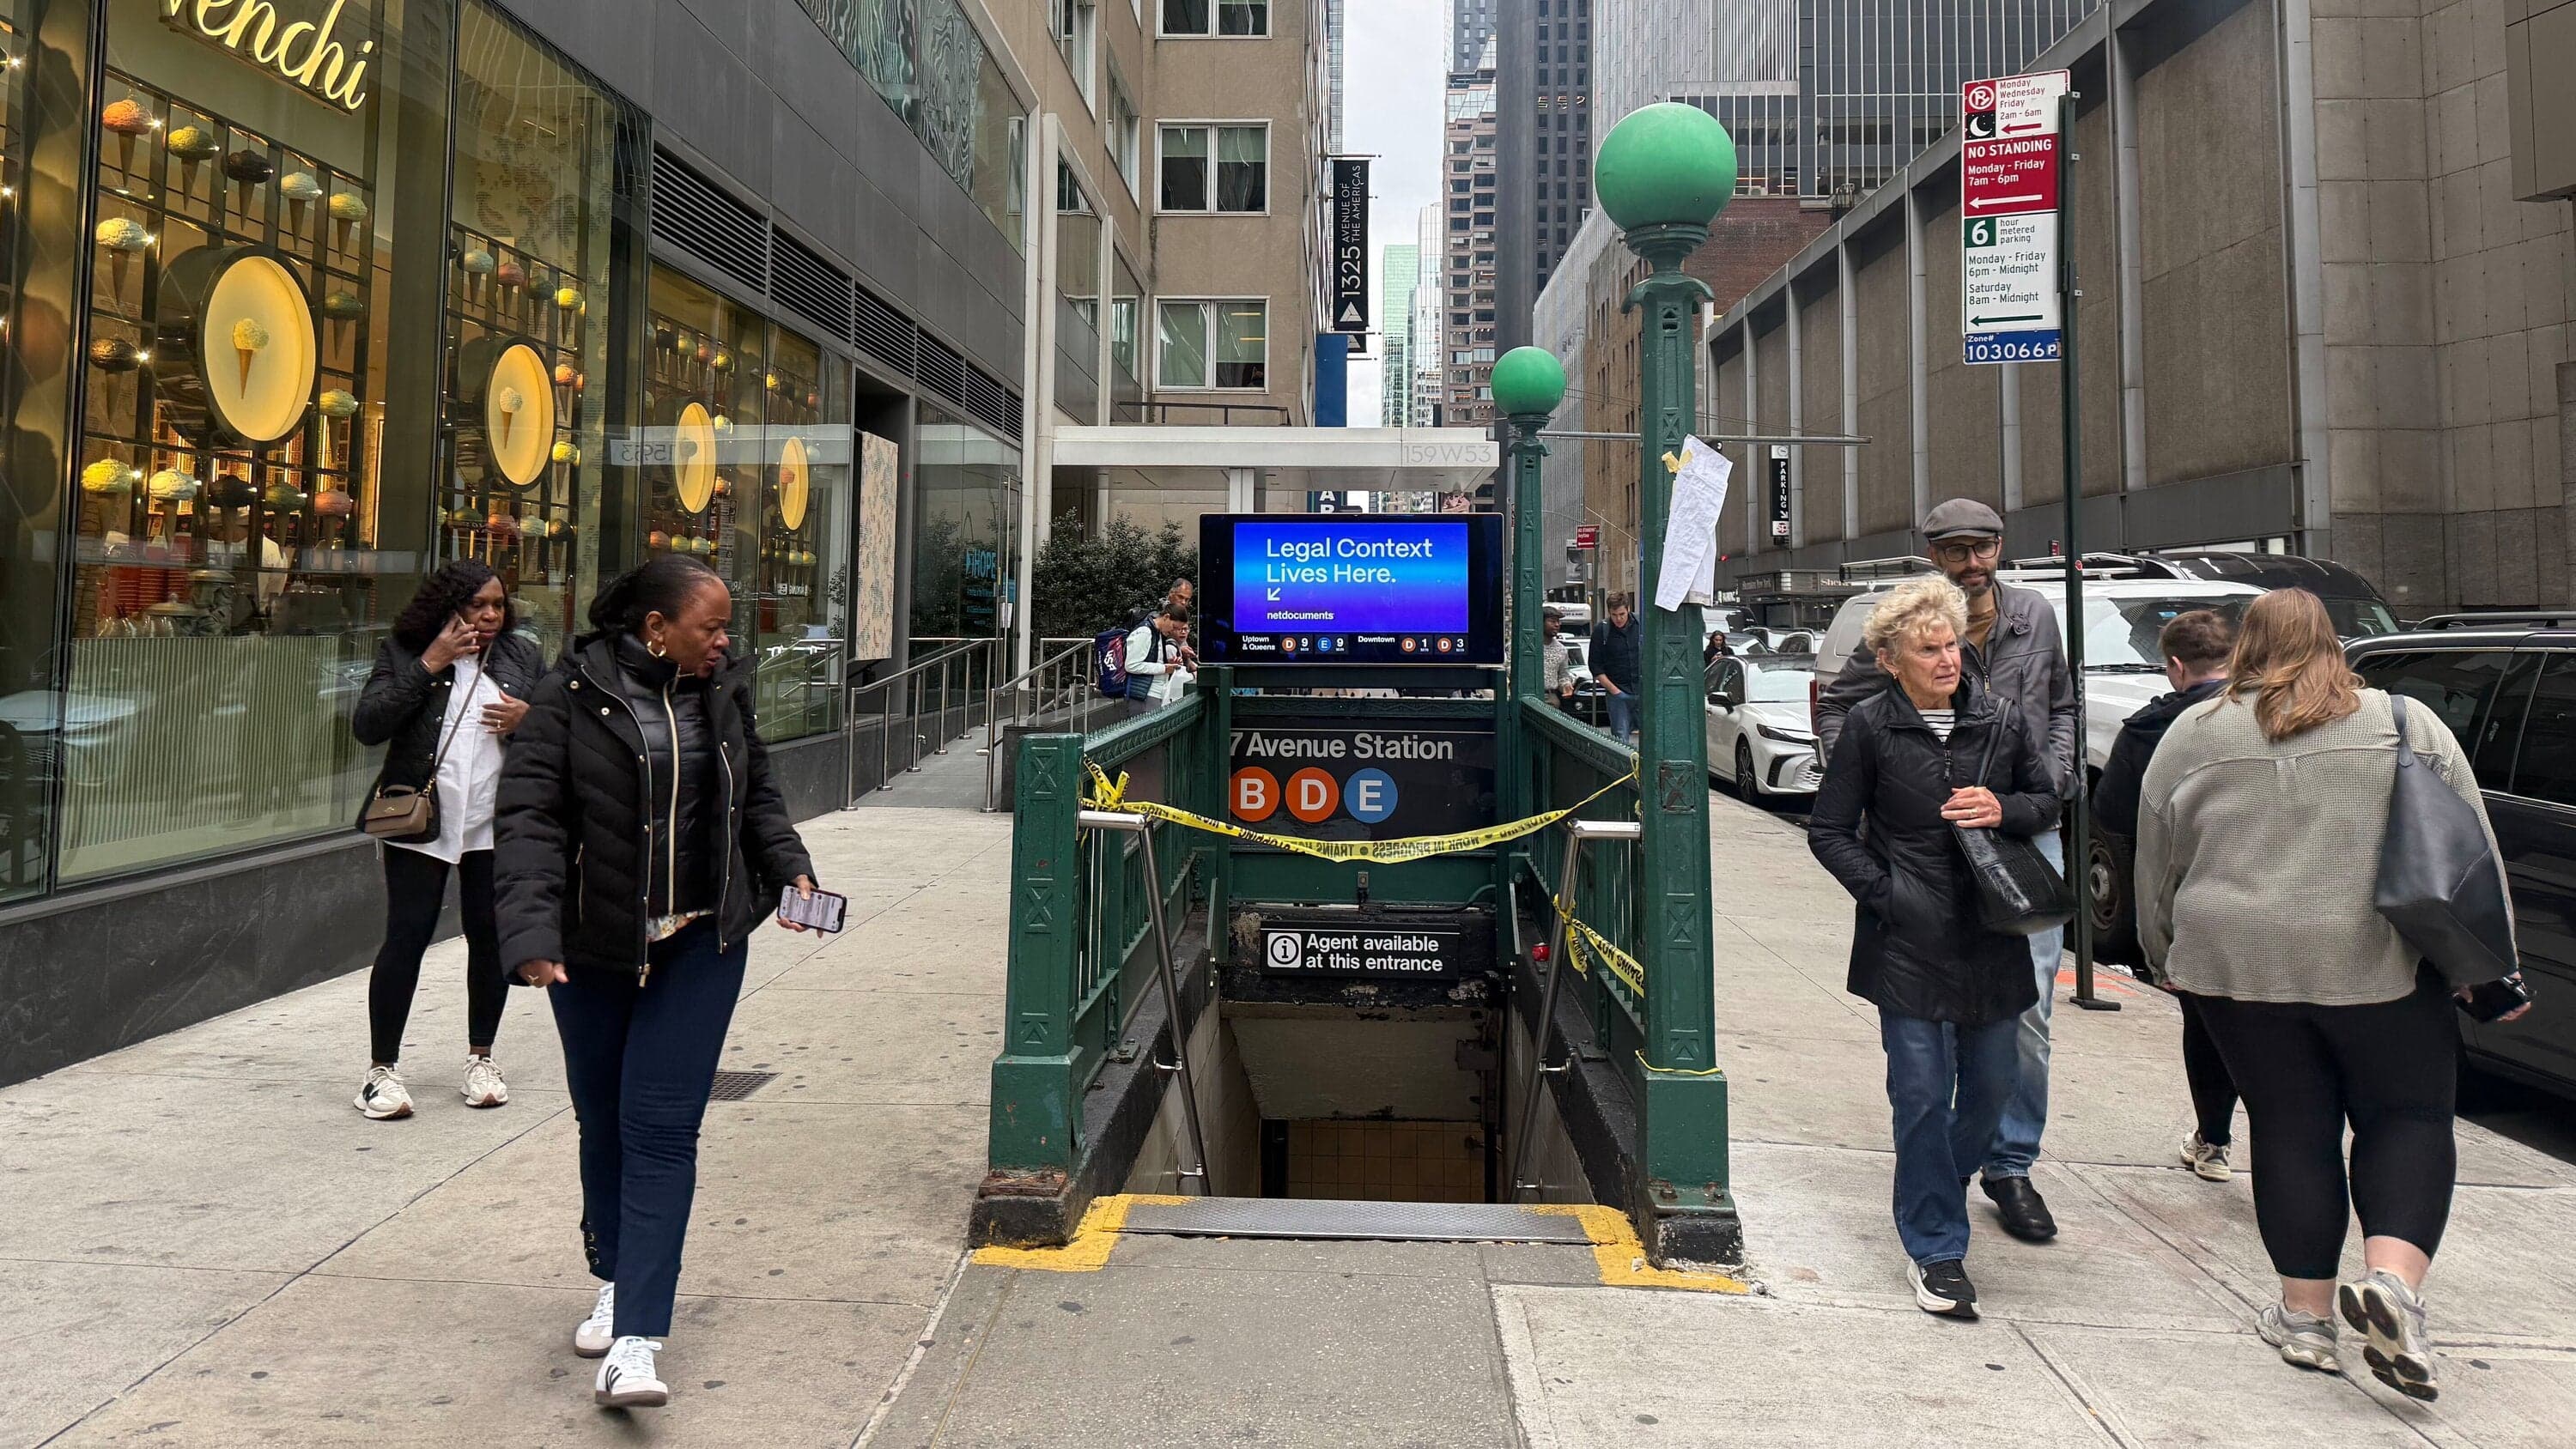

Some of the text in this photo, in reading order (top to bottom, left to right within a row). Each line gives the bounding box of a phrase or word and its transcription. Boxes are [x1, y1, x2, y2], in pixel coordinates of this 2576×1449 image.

[171, 0, 374, 110] enchi
[2001, 78, 2031, 89] Monday
[2001, 86, 2045, 99] Wednesday
[2001, 98, 2025, 109] Friday
[2001, 111, 2018, 119] 2am
[2025, 108, 2042, 117] 6am
[1968, 138, 2052, 159] NO STANDING
[1968, 163, 2006, 176] Monday
[2014, 159, 2045, 172] Friday
[1968, 176, 1989, 186] 7am
[1997, 173, 2019, 186] 6pm
[1352, 165, 1361, 242] THE AMERICAS
[1342, 183, 1351, 243] AVENUE OF
[2001, 218, 2019, 227] hour
[1971, 220, 1989, 246] 6
[2001, 225, 2035, 235] metered
[2001, 233, 2031, 245] parking
[1968, 254, 2006, 266] Monday
[2015, 251, 2046, 263] Friday
[1341, 246, 1361, 298] 1325
[1969, 266, 1990, 277] 6pm
[2000, 263, 2038, 276] Midnight
[1969, 282, 2012, 294] Saturday
[1969, 295, 1989, 306] 8am
[2000, 292, 2038, 305] Midnight
[1968, 335, 1994, 343] Zone#
[1967, 343, 2044, 361] 103066
[1267, 537, 1433, 563] Legal Context
[1267, 563, 1397, 584] Lives Here.
[1267, 610, 1334, 621] netdocuments
[1242, 635, 1269, 644] Uptown
[1301, 638, 1309, 648] 9
[1336, 638, 1344, 648] 9
[1422, 639, 1428, 647] 1
[1456, 639, 1464, 648] 3
[1104, 649, 1116, 671] USA
[1230, 732, 1454, 760] 7 Avenue Station
[1240, 778, 1383, 811] B D E
[1305, 933, 1439, 953] Agent available
[1305, 953, 1443, 972] at this entrance
